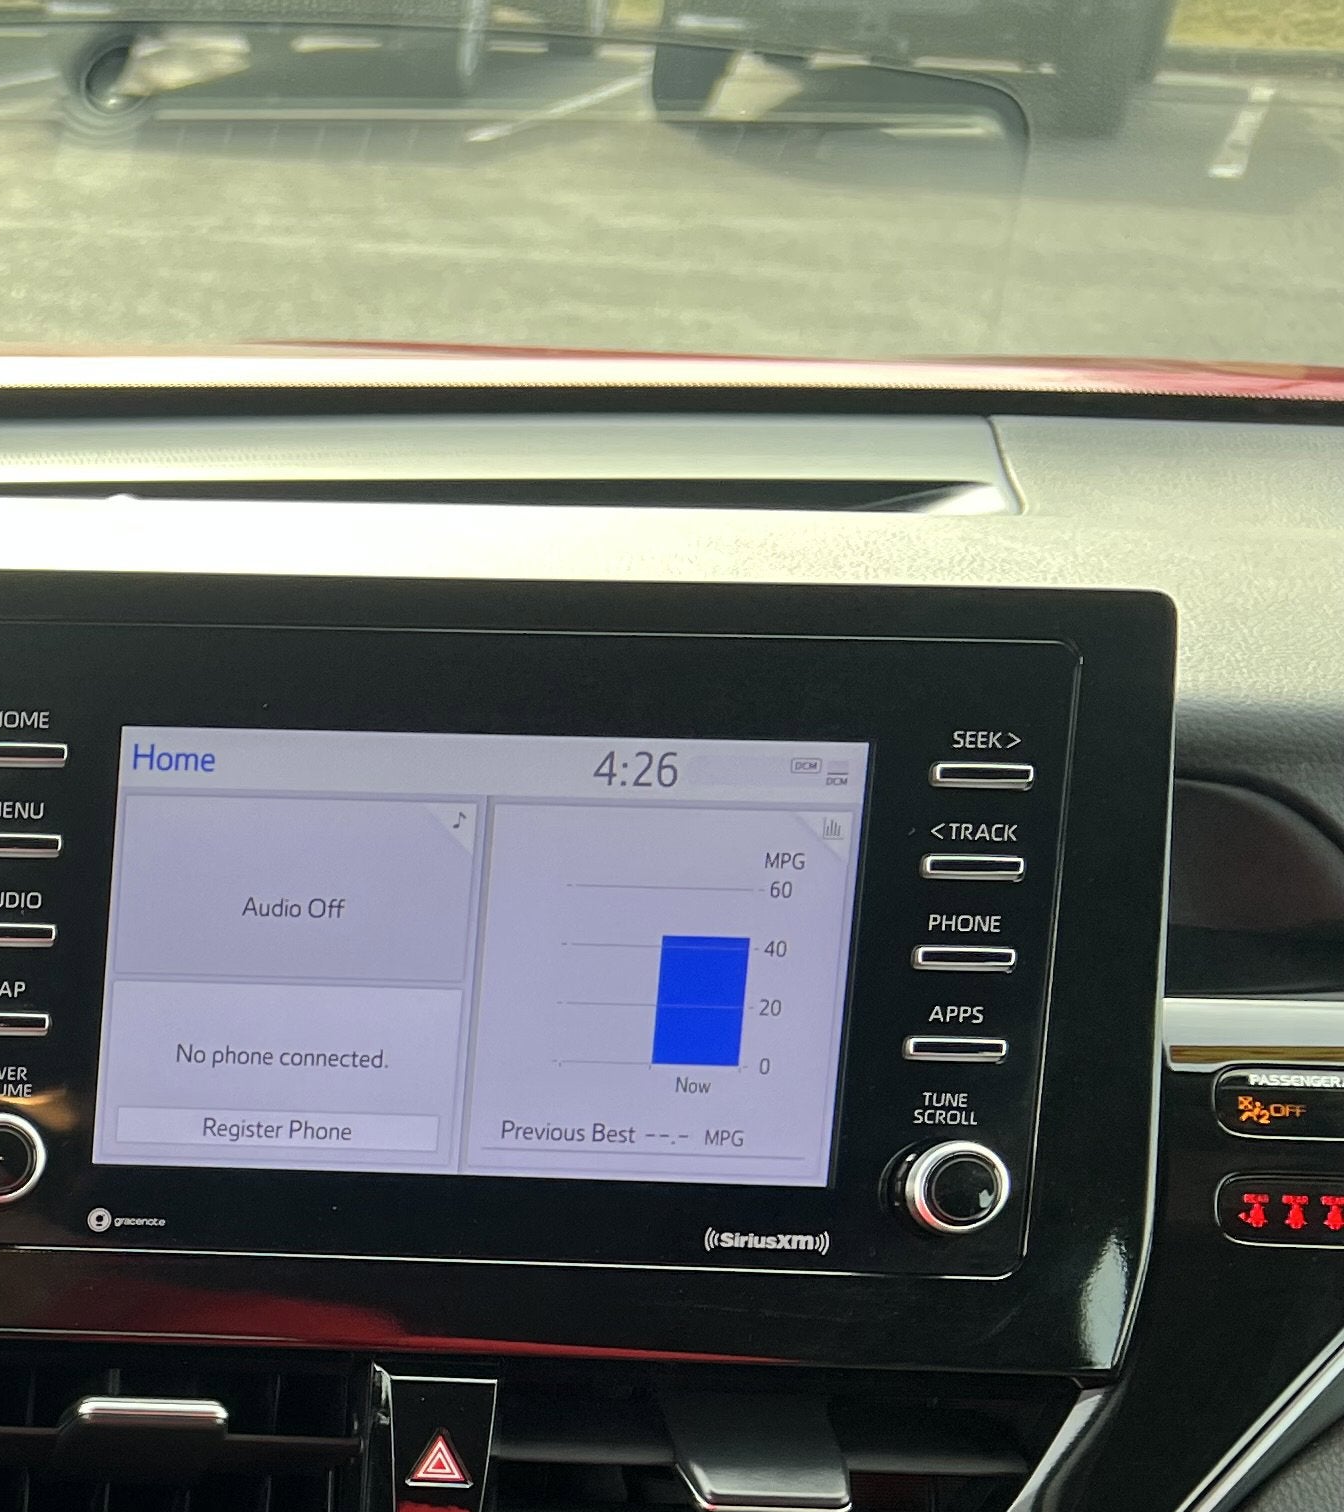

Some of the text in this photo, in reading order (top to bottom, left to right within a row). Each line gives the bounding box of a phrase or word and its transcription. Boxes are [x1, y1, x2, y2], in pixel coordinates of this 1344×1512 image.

[131, 743, 216, 773] Home
[593, 750, 678, 788] 4:26
[825, 777, 848, 786] DCM
[764, 852, 806, 872] MPG
[769, 881, 793, 899] 60
[242, 898, 346, 919] Audio Off
[928, 914, 1001, 933] PHONE
[764, 940, 788, 958] 40
[759, 999, 782, 1017] 20
[928, 1006, 984, 1024] APPS
[176, 1043, 389, 1070] No phone connected.
[759, 1058, 771, 1075] 0
[675, 1077, 711, 1094] Now
[1248, 1073, 1340, 1088] PASSENGER
[922, 1092, 968, 1108] TUNE
[913, 1110, 978, 1126] SCROLL
[1270, 1104, 1307, 1117] OFF
[202, 1117, 353, 1141] Register Phone
[500, 1120, 586, 1143] Previous
[591, 1124, 636, 1145] Best
[704, 1129, 744, 1147] MPG
[114, 1217, 166, 1227] gracenote
